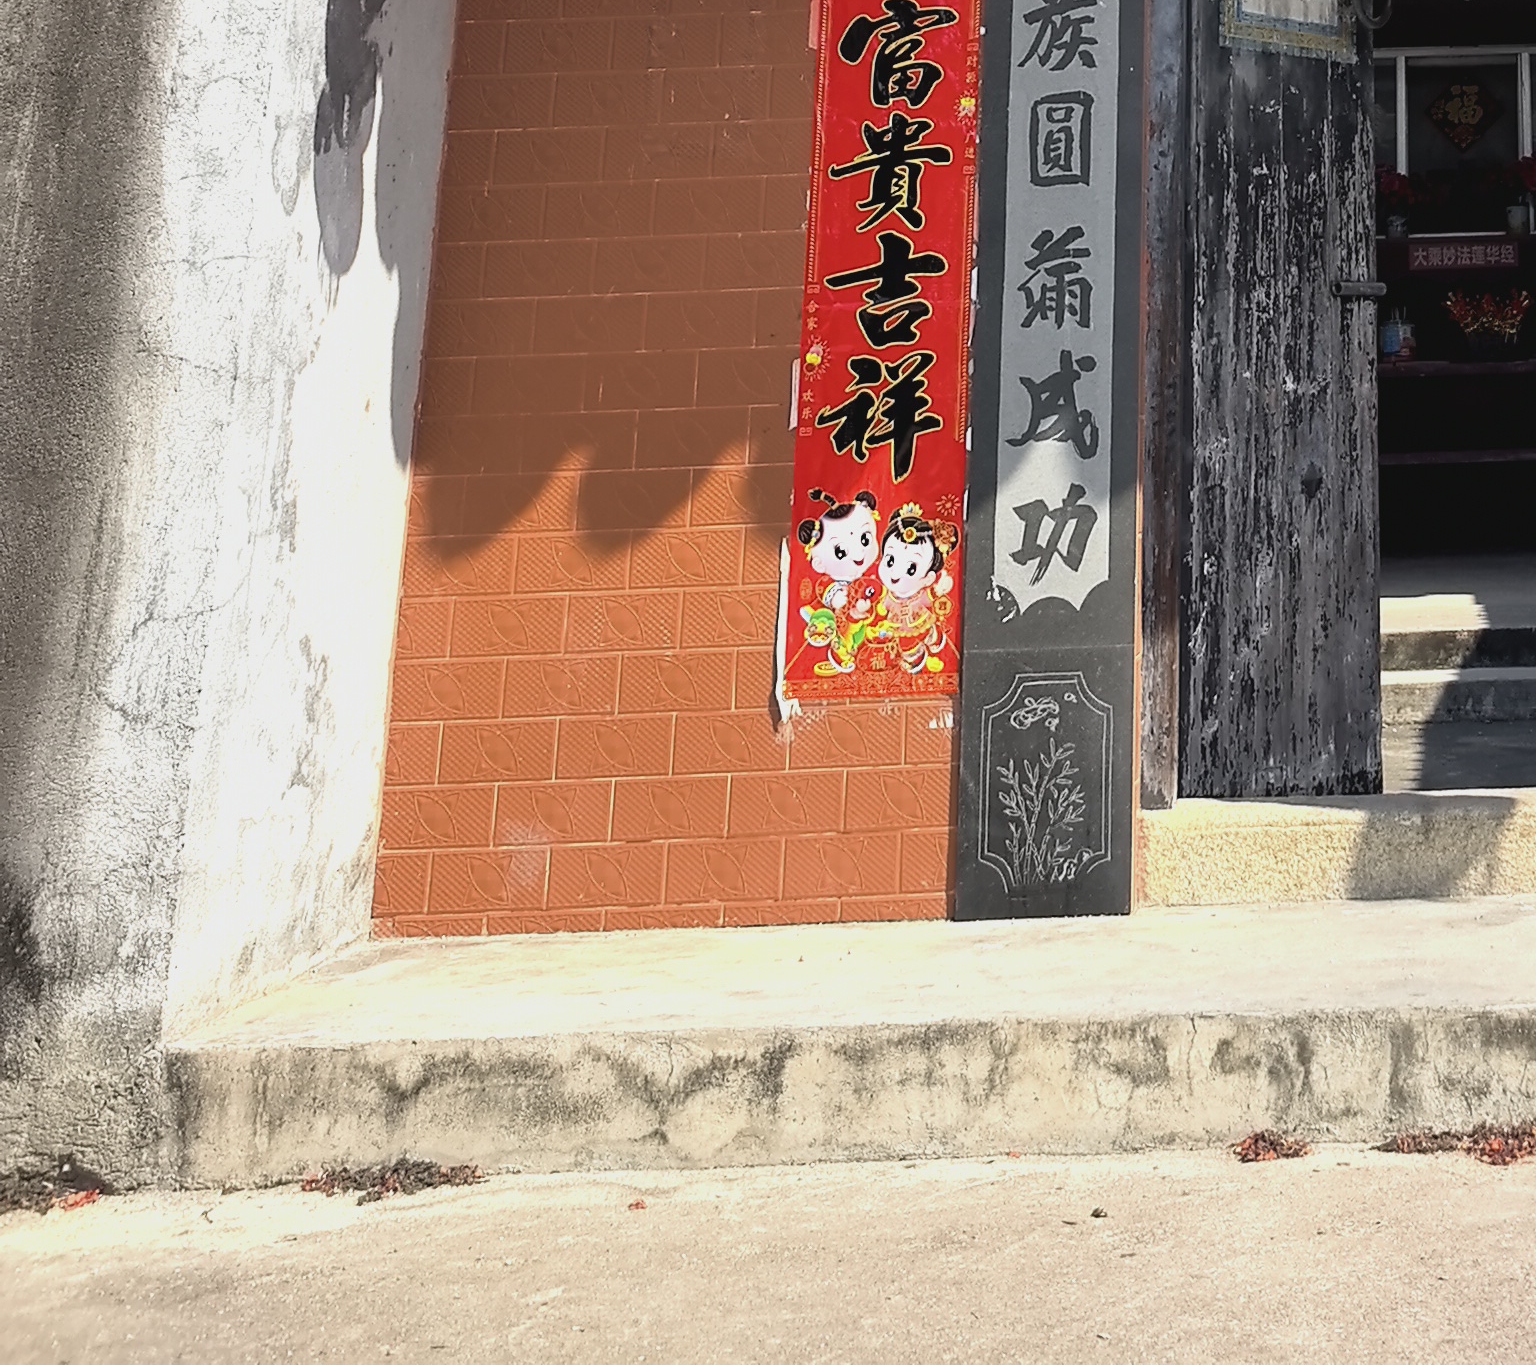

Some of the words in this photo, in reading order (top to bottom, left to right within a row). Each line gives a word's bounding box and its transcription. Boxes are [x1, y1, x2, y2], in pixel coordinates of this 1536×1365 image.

[1444, 84, 1484, 125] 福
[805, 300, 820, 330] 合家
[801, 389, 816, 420] 欢乐
